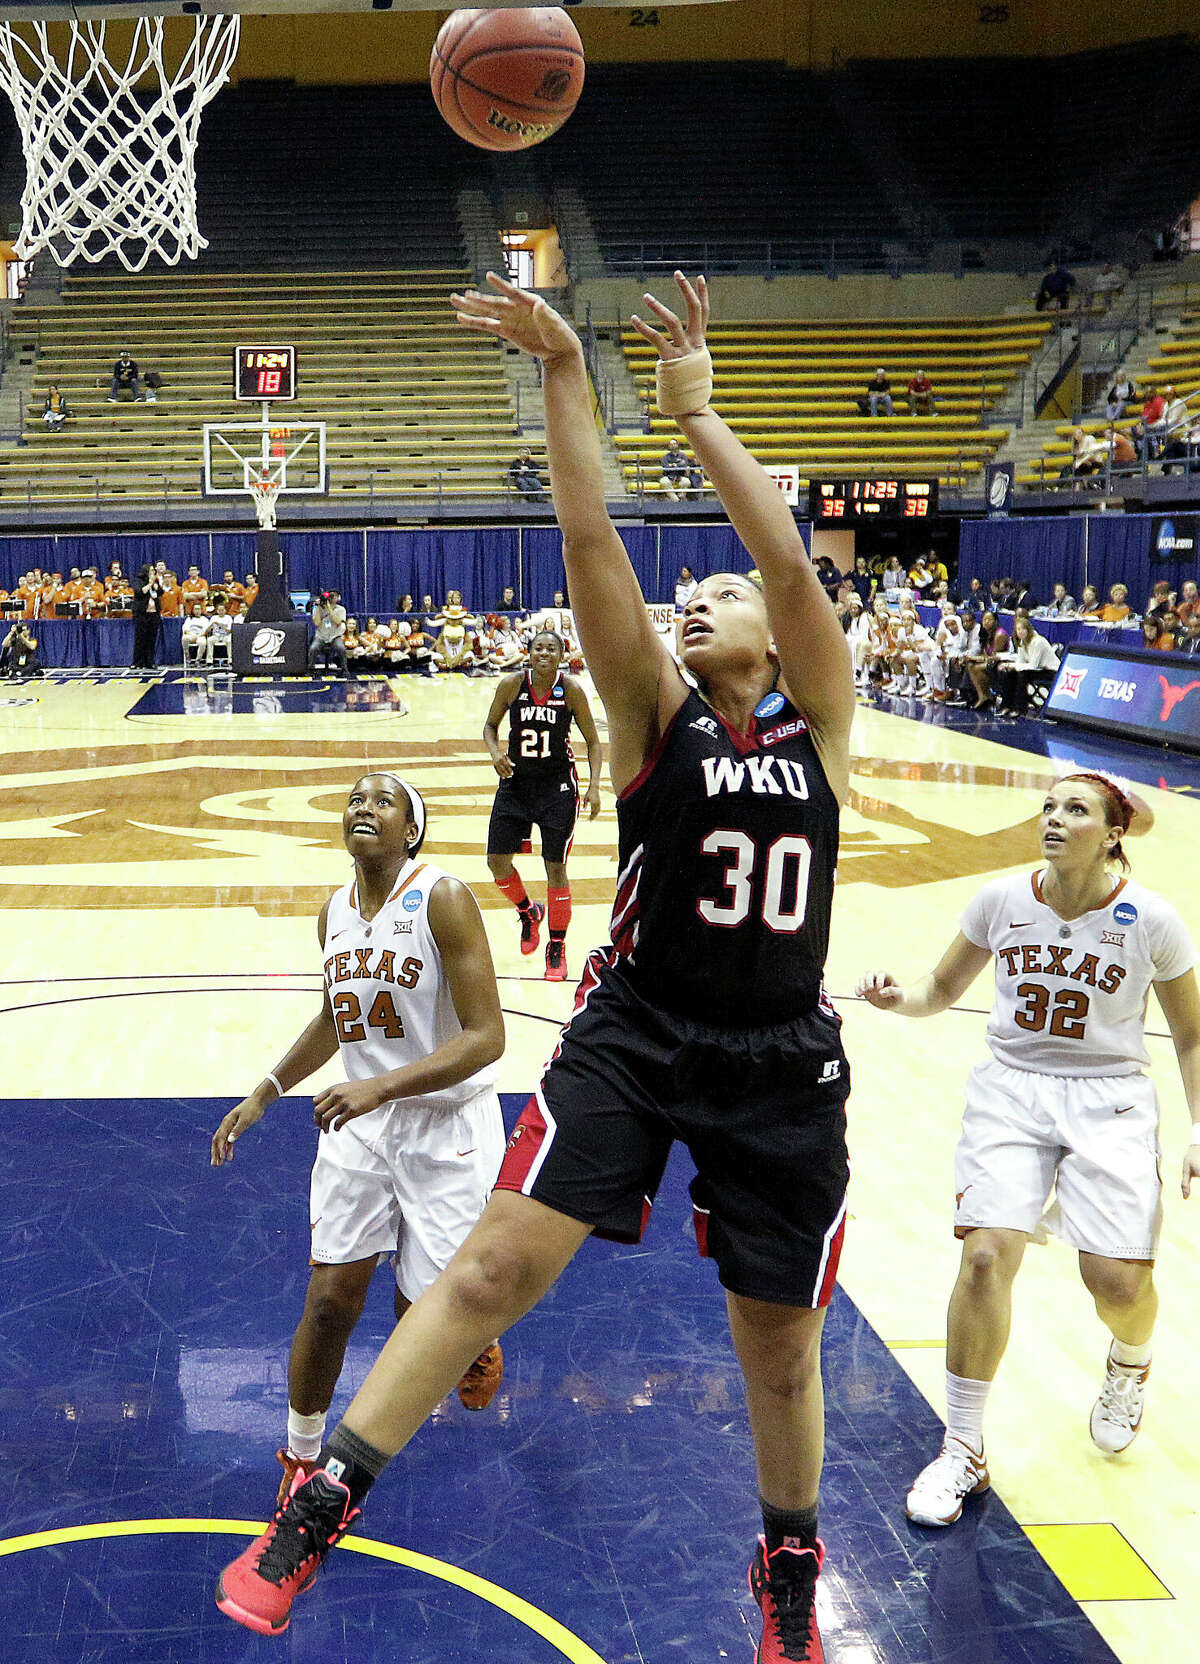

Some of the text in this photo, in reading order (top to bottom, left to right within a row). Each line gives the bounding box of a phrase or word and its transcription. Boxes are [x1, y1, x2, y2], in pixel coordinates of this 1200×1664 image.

[630, 9, 661, 27] 24
[257, 371, 281, 393] 18
[853, 481, 898, 499] 11:25
[822, 499, 845, 517] 35
[904, 499, 928, 517] 39
[648, 608, 673, 623] ENSE
[1098, 677, 1137, 702] TEXAS
[520, 706, 557, 724] WKU
[758, 696, 784, 716] NCAA
[520, 729, 551, 758] 21
[701, 755, 809, 800] WKU
[696, 828, 814, 934] 30
[1115, 910, 1137, 921] NCAA
[324, 948, 423, 990] TEXAS
[999, 945, 1127, 994] TEXAS
[333, 991, 405, 1043] 24
[1015, 983, 1090, 1039] 32
